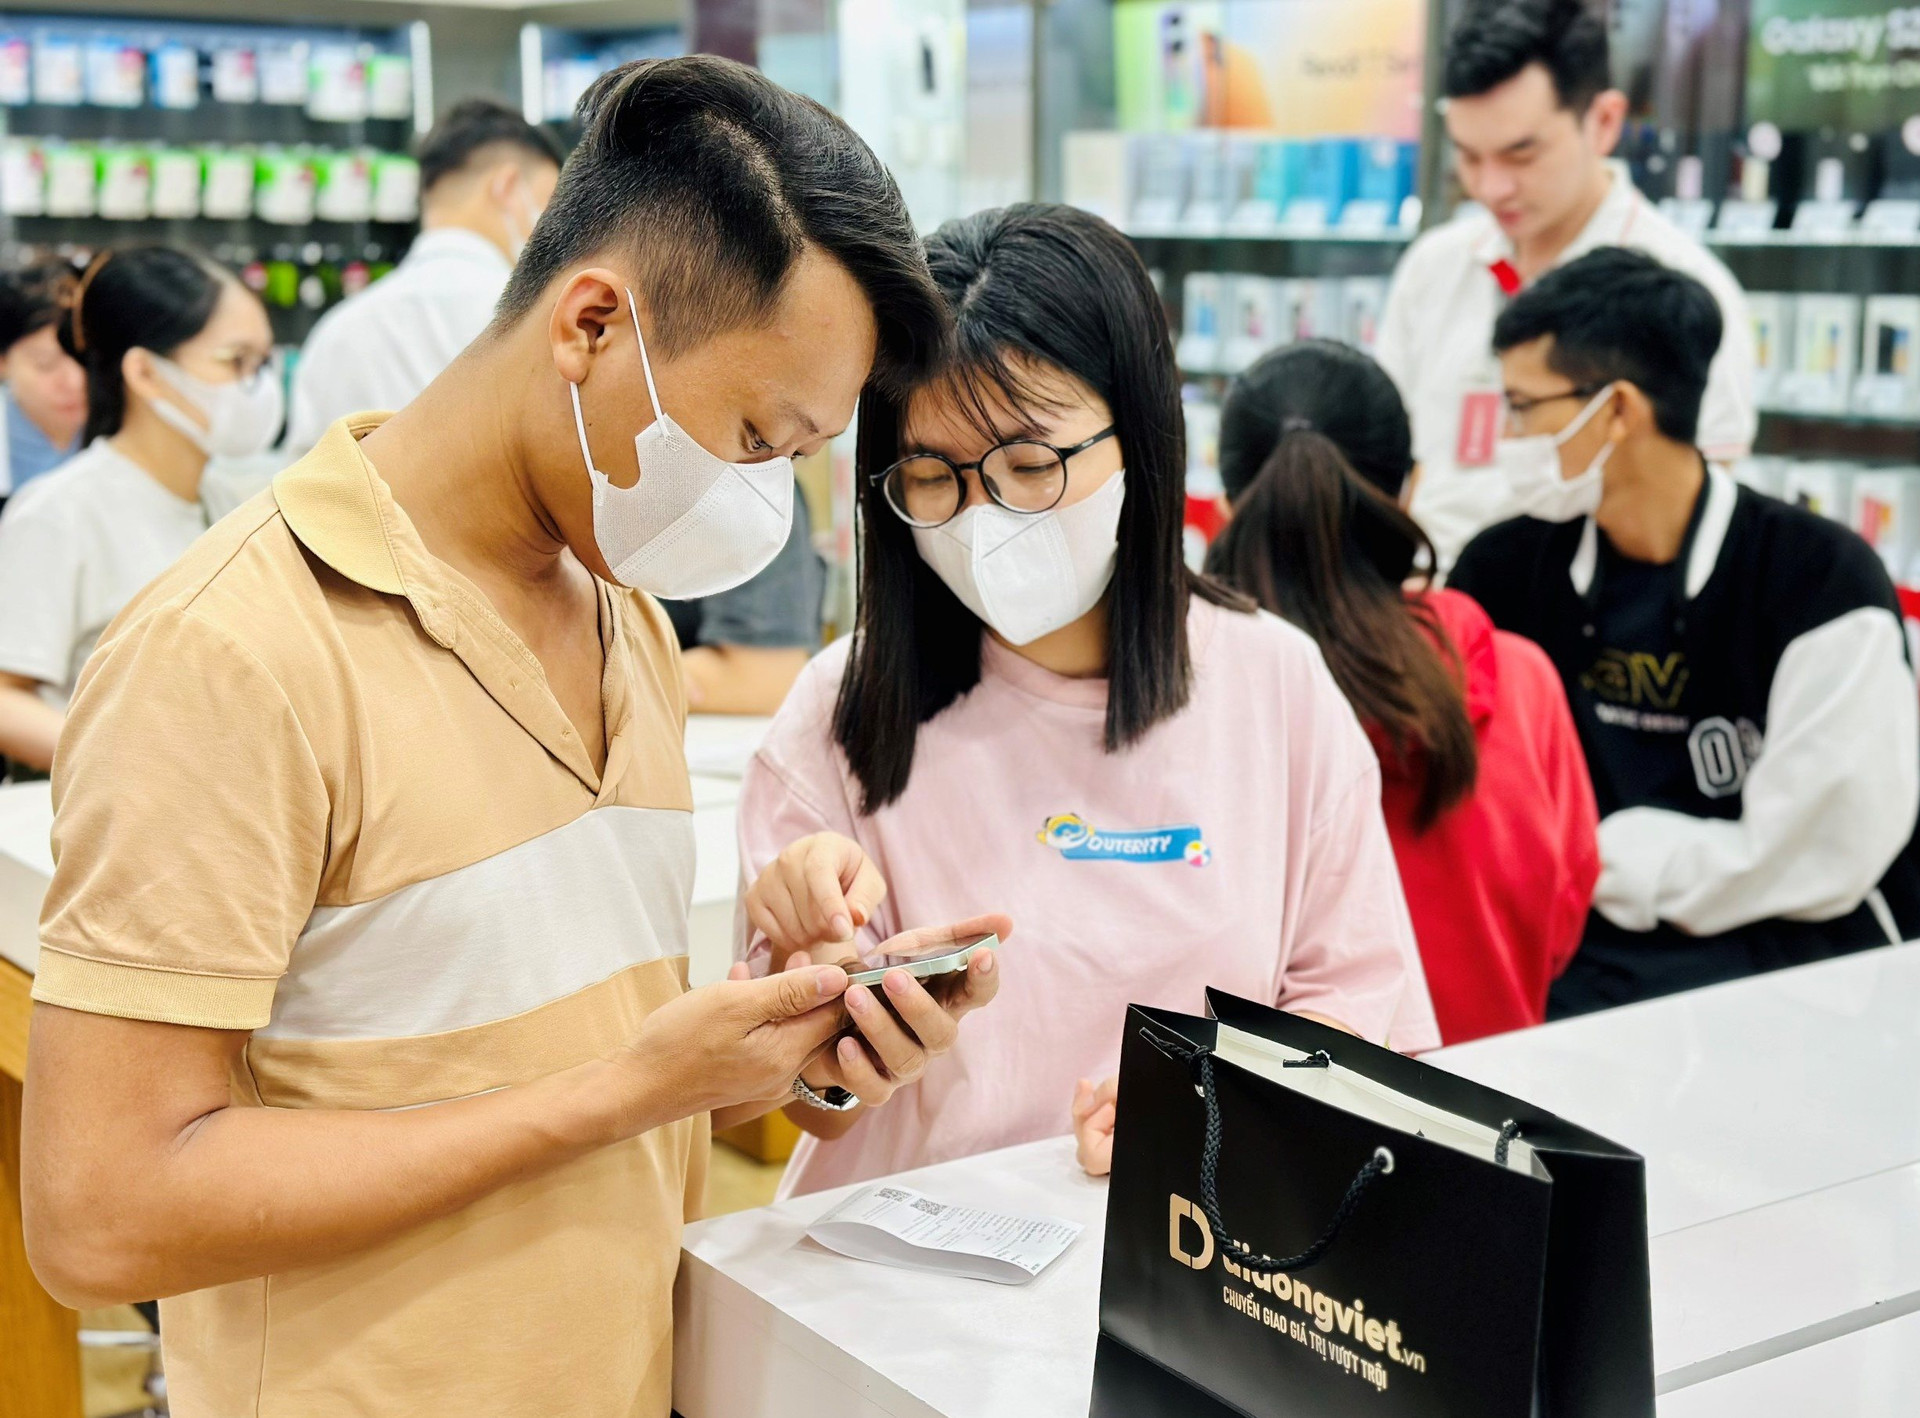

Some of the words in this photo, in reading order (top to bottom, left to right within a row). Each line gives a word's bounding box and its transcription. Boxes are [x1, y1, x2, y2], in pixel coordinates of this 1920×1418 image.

[1760, 14, 1883, 62] Galaxy
[1086, 835, 1173, 855] OUTERITY
[1223, 1285, 1260, 1321] CHUYỂN
[1263, 1306, 1287, 1334] GIAO
[1290, 1320, 1308, 1346] GIÁ
[1309, 1330, 1326, 1361] TRỊ
[1328, 1341, 1359, 1374] VƯỢT
[1361, 1358, 1388, 1392] TRỘI
